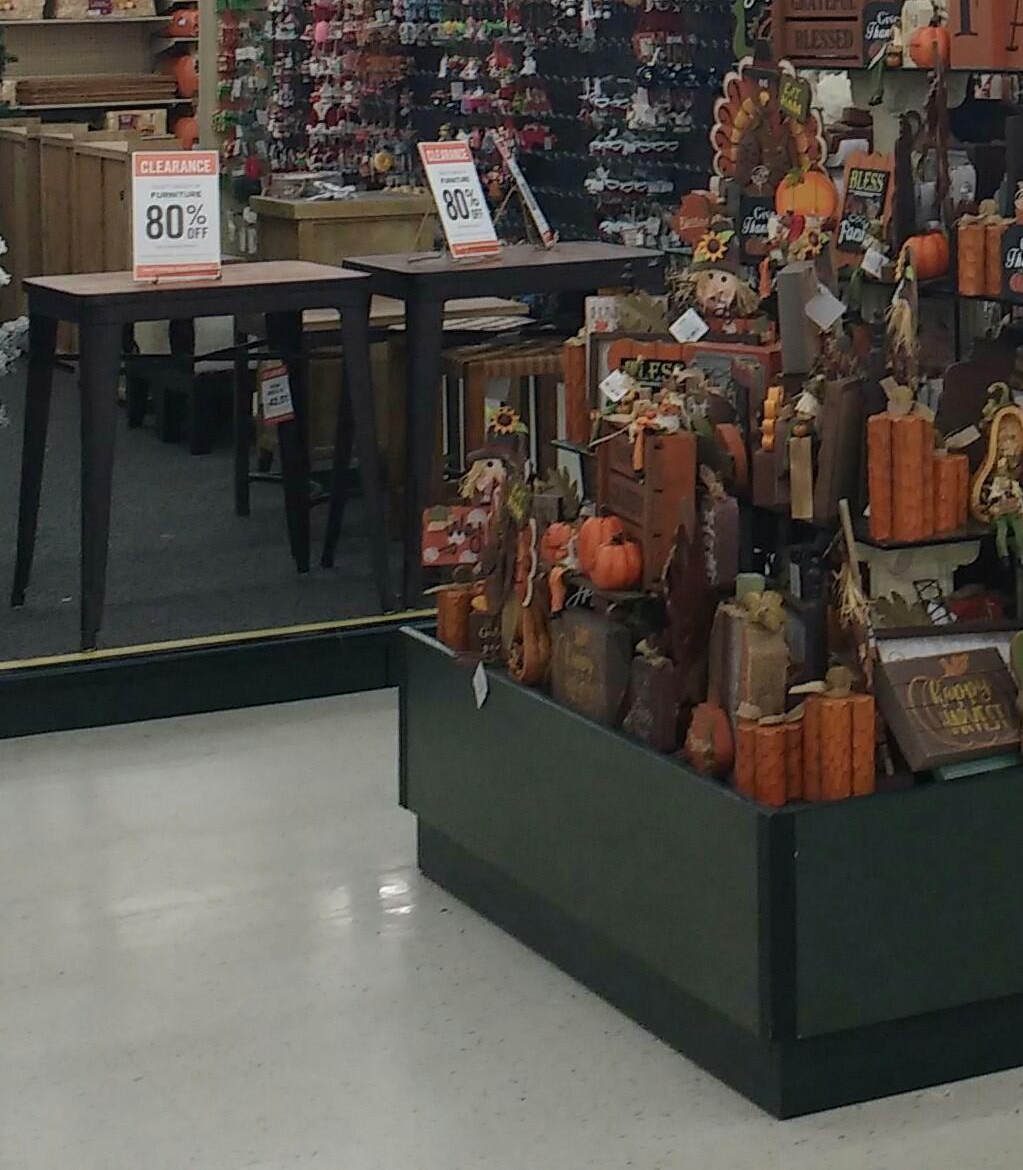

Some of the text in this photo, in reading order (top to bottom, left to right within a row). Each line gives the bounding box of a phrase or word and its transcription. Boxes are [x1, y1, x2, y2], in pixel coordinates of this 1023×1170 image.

[795, 28, 854, 50] BLESSED
[865, 21, 894, 40] Than
[140, 158, 212, 174] CLEARANCE
[849, 169, 886, 192] BLESS
[150, 190, 202, 199] FURNITURE
[187, 227, 208, 239] OFF
[638, 362, 687, 380] LESS
